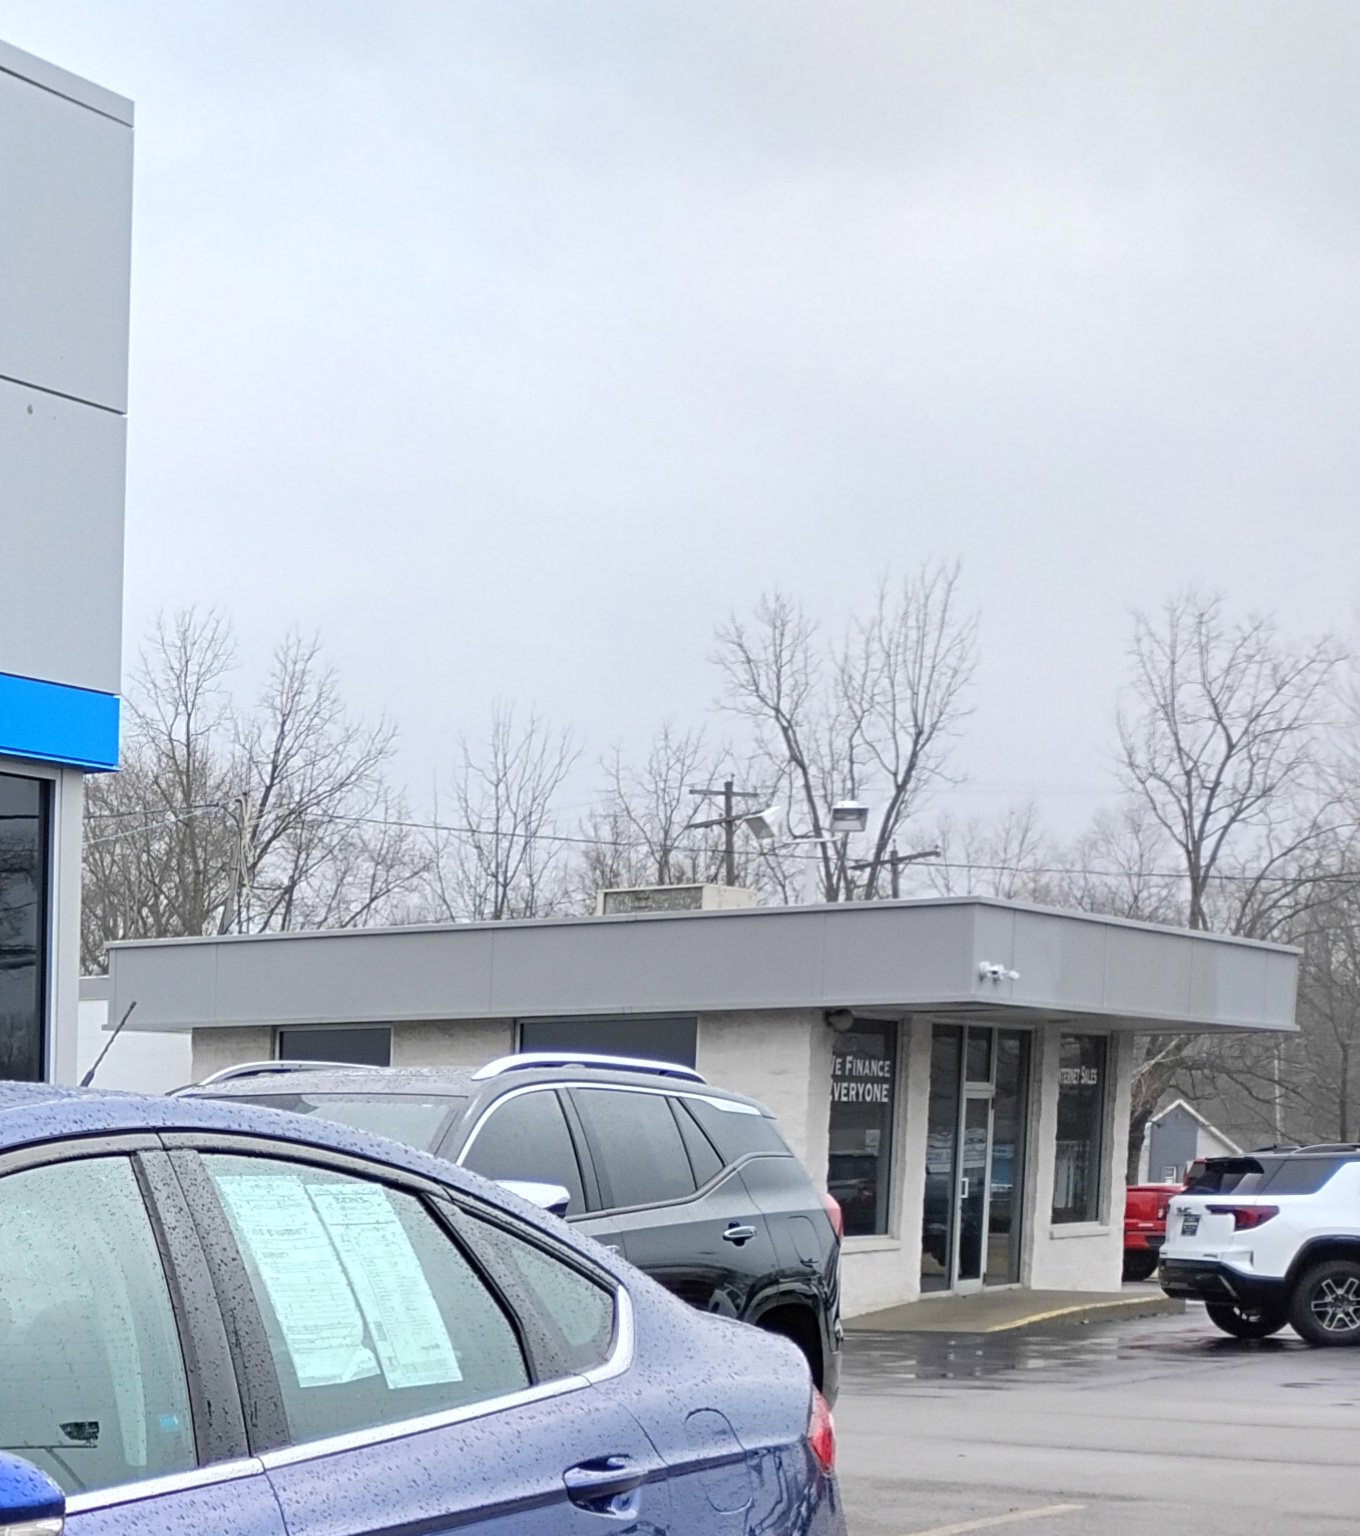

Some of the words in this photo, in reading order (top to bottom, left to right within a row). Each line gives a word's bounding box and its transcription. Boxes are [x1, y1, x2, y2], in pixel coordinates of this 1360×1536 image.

[832, 1055, 842, 1075] E
[845, 1055, 891, 1077] FINANCE
[832, 1081, 890, 1102] VERYONE
